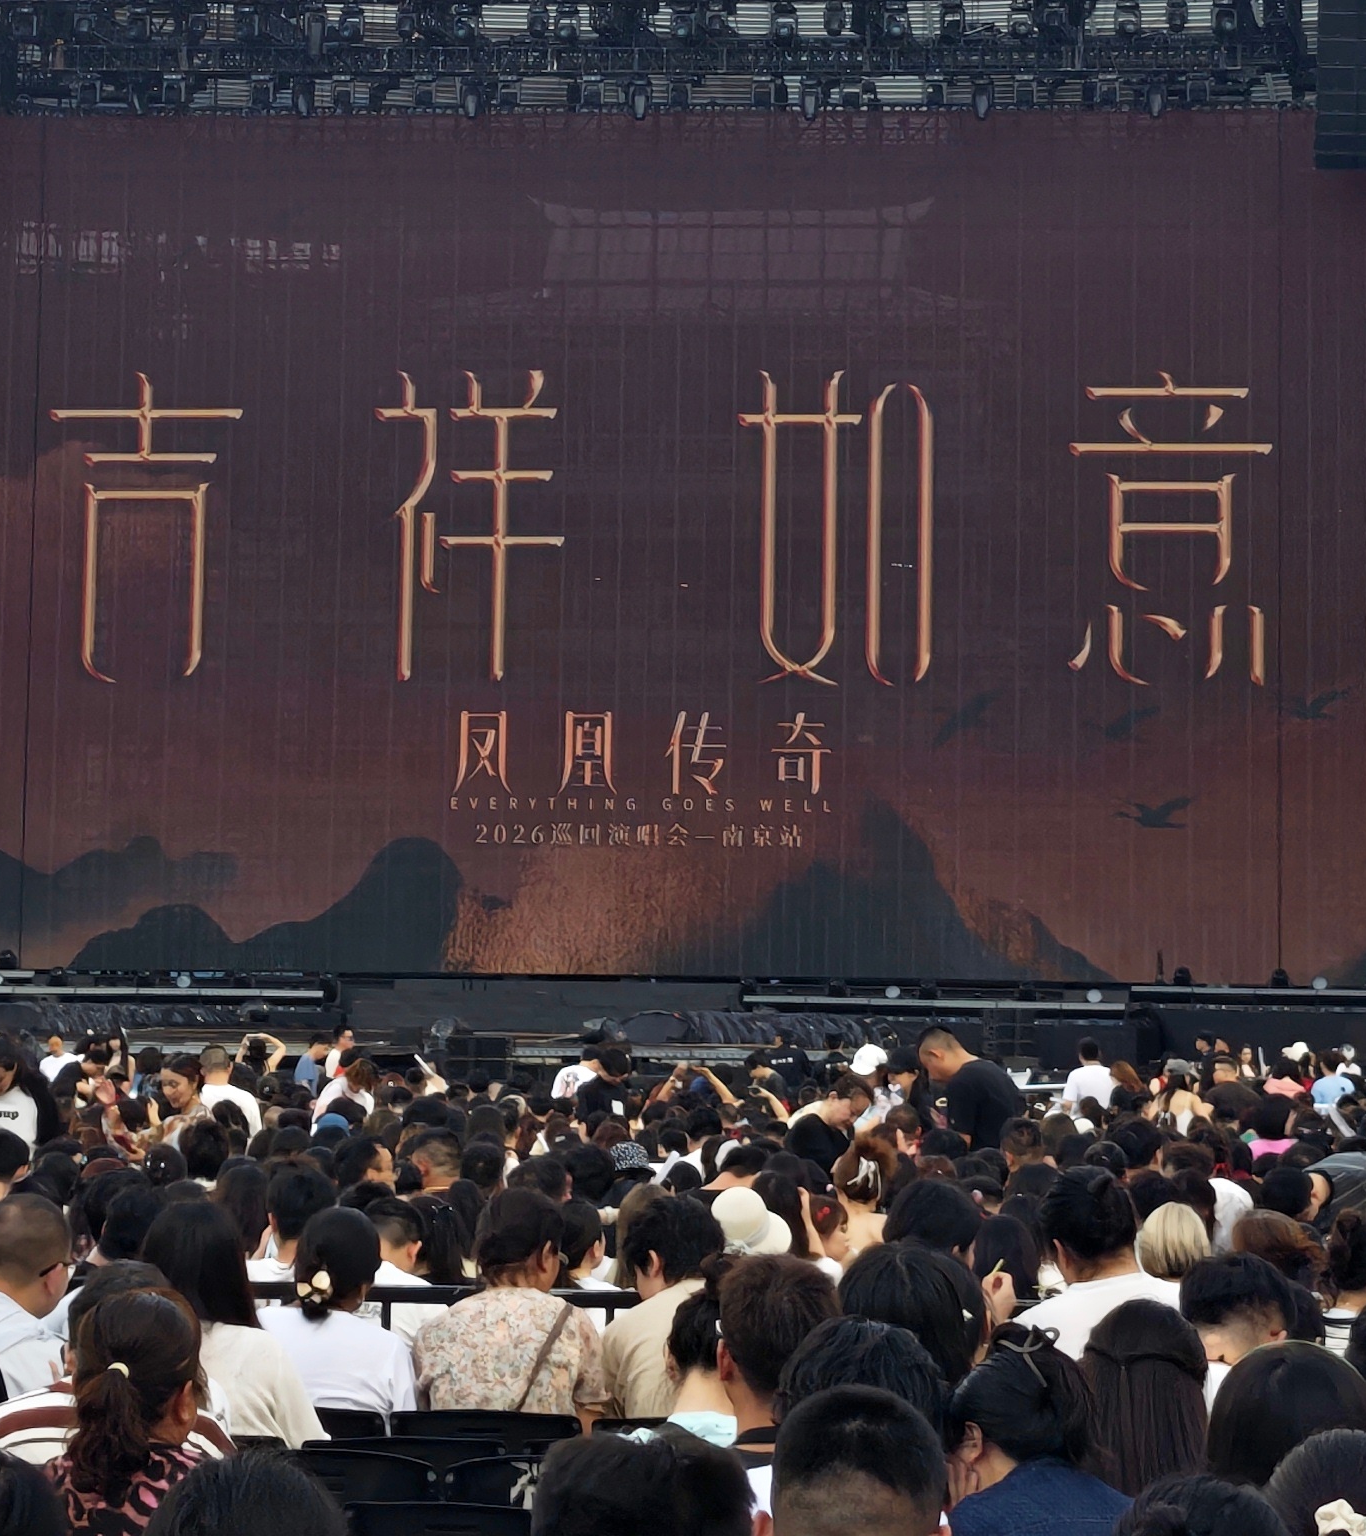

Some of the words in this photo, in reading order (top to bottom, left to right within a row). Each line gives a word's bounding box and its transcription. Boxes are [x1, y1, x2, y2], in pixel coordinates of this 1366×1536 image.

[48, 369, 1273, 686] 吉祥如意
[453, 709, 833, 796] 凤凰传奇
[449, 797, 636, 812] EVERYTHING
[662, 797, 735, 812] GOES
[759, 798, 832, 813] WELL
